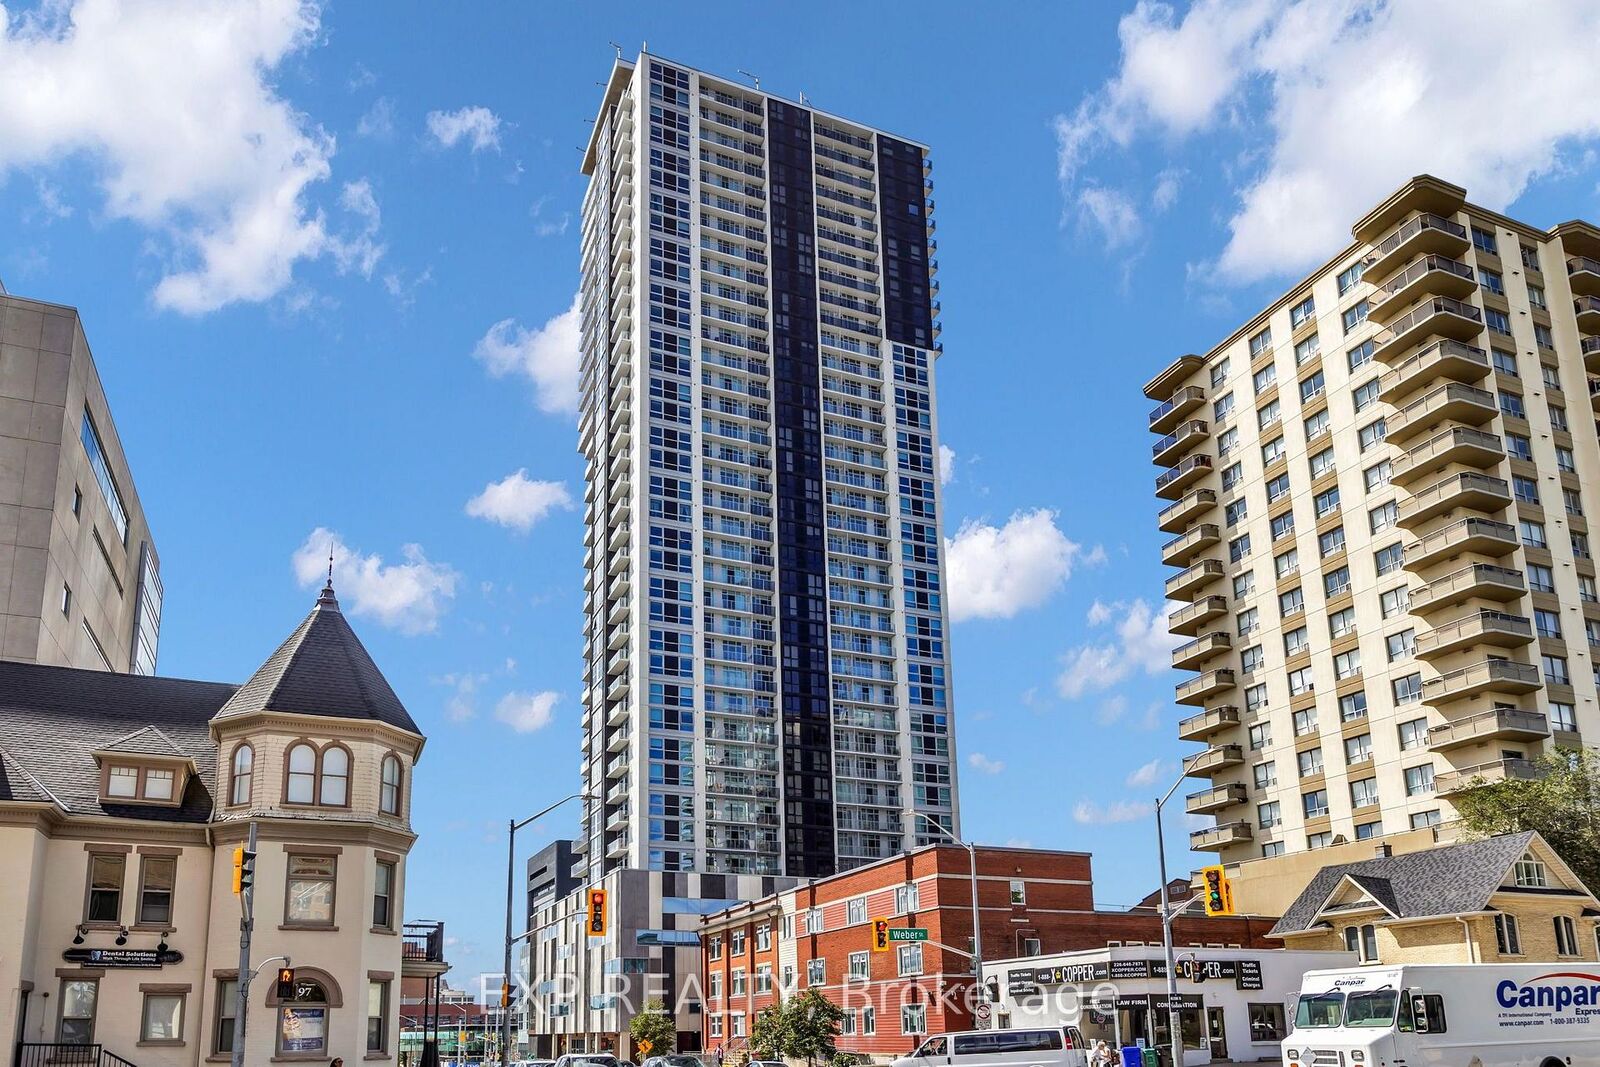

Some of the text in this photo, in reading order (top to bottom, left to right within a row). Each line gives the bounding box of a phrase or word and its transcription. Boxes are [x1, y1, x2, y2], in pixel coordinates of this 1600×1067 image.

[893, 930, 918, 939] Weber
[1050, 968, 1056, 984] X
[1062, 965, 1095, 983] COPPER
[1183, 961, 1221, 978] CPER
[298, 987, 312, 997] 97
[1496, 980, 1600, 1012] Canpar
